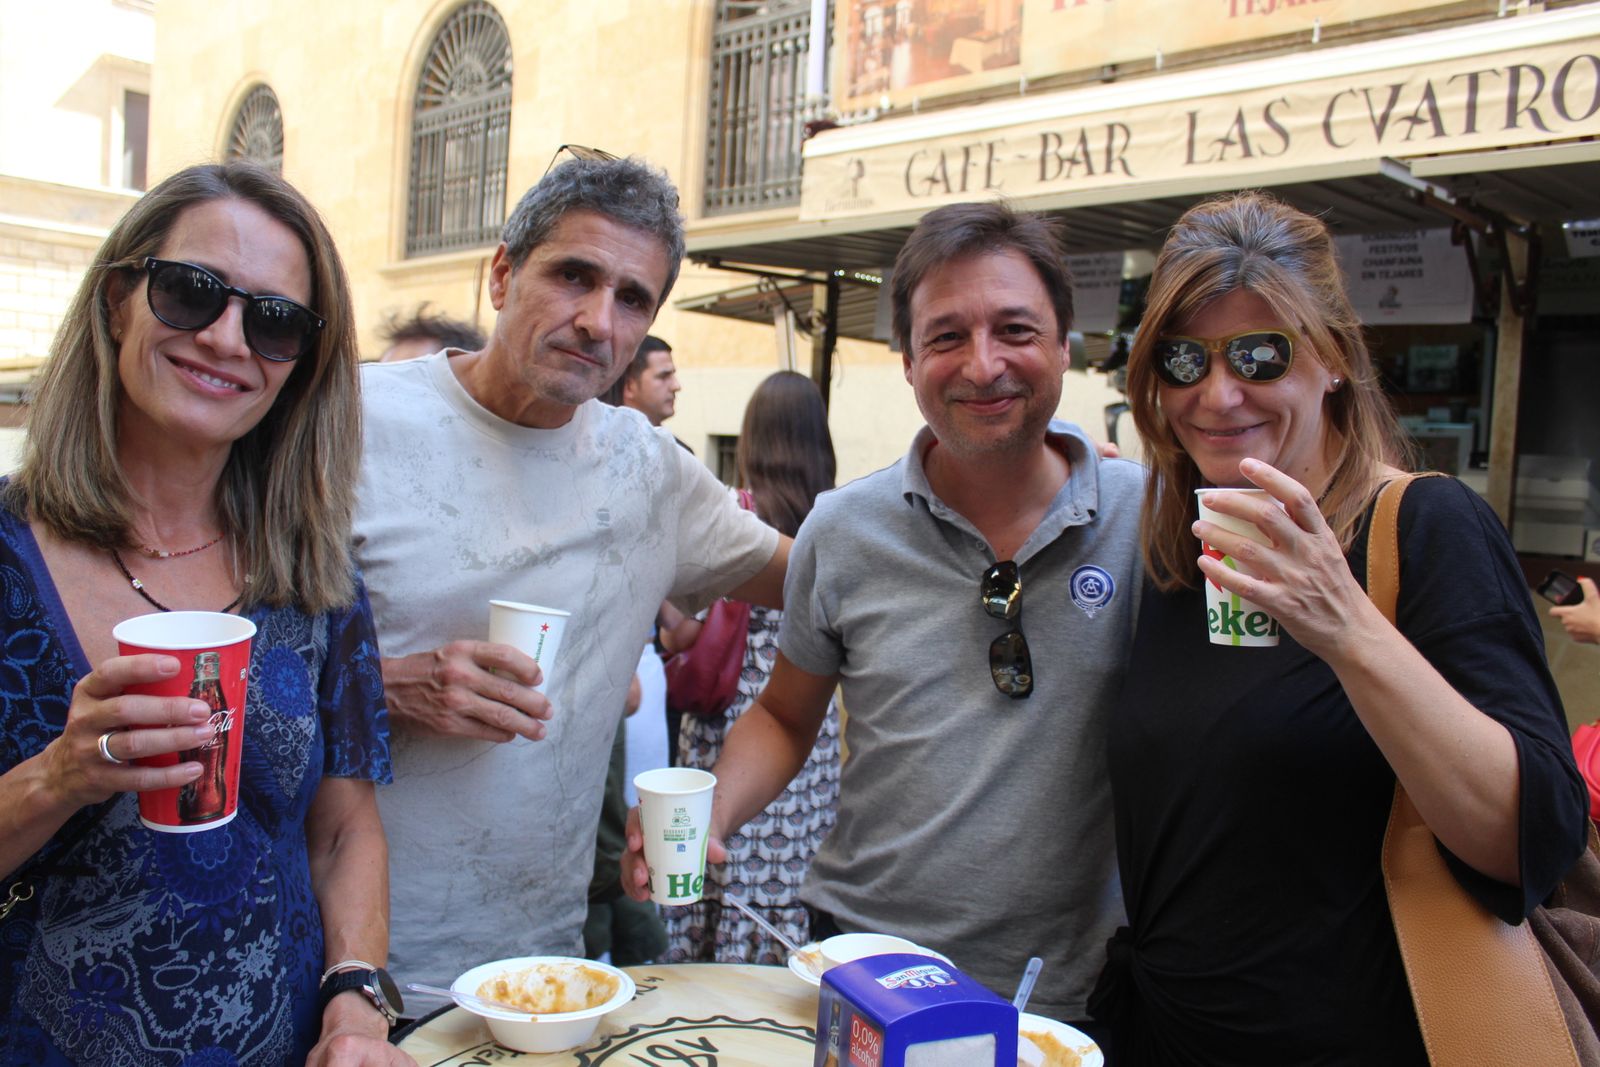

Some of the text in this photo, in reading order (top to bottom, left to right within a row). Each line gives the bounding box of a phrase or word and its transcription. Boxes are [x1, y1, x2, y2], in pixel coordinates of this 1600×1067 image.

[1182, 96, 1293, 166] LAS
[1369, 243, 1419, 254] FESTIVOS
[1362, 256, 1423, 268] CHANFAINA
[1361, 269, 1424, 280] EN TEJARES
[852, 1019, 879, 1055] 0,0%
